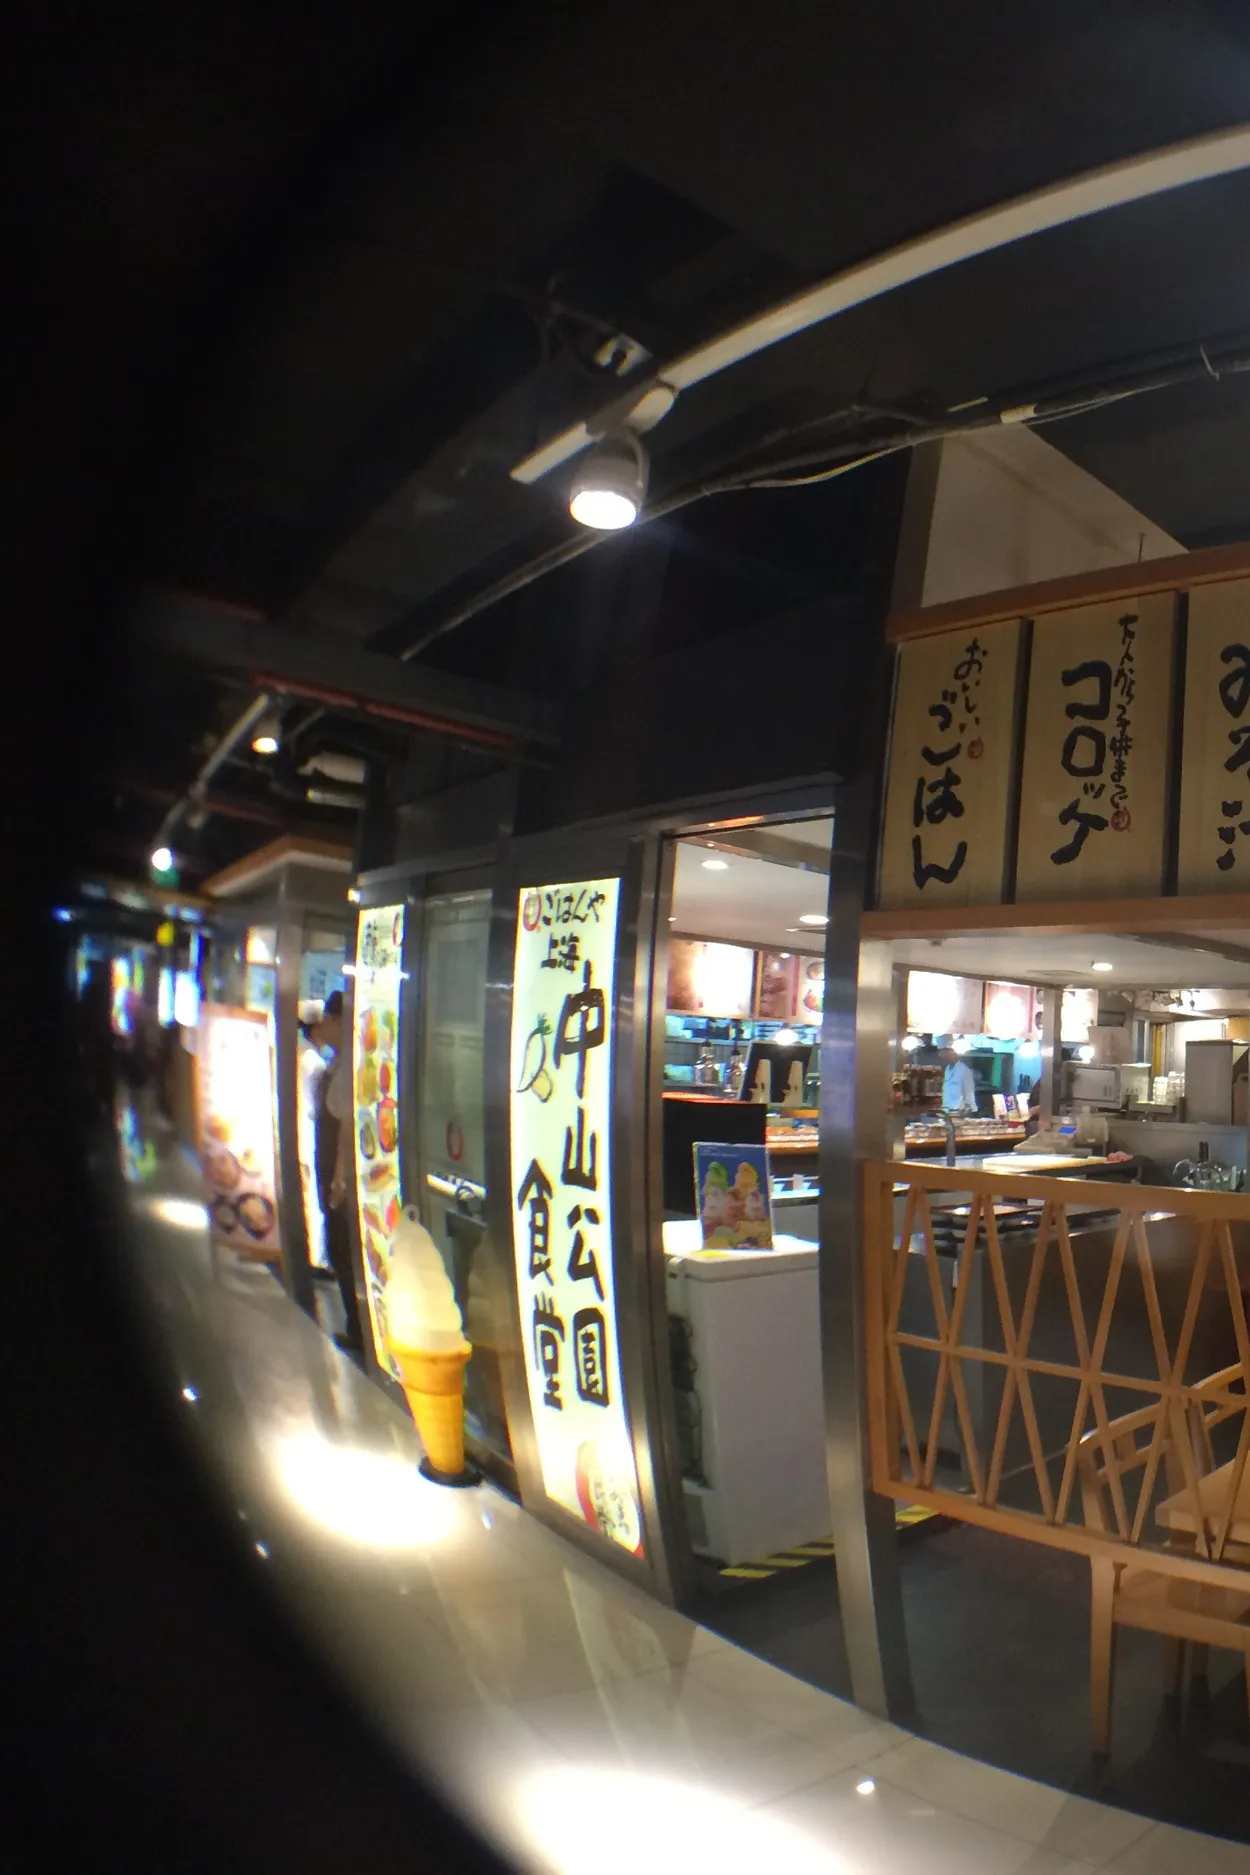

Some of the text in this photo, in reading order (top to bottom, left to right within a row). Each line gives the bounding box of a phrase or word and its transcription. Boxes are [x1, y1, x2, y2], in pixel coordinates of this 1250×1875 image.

[953, 637, 988, 734] おいしい
[912, 688, 967, 890] ごはん
[1050, 659, 1114, 866] コロッケ
[540, 931, 581, 974] 上海
[541, 888, 608, 926] ごはんや
[517, 1158, 566, 1412] 食堂
